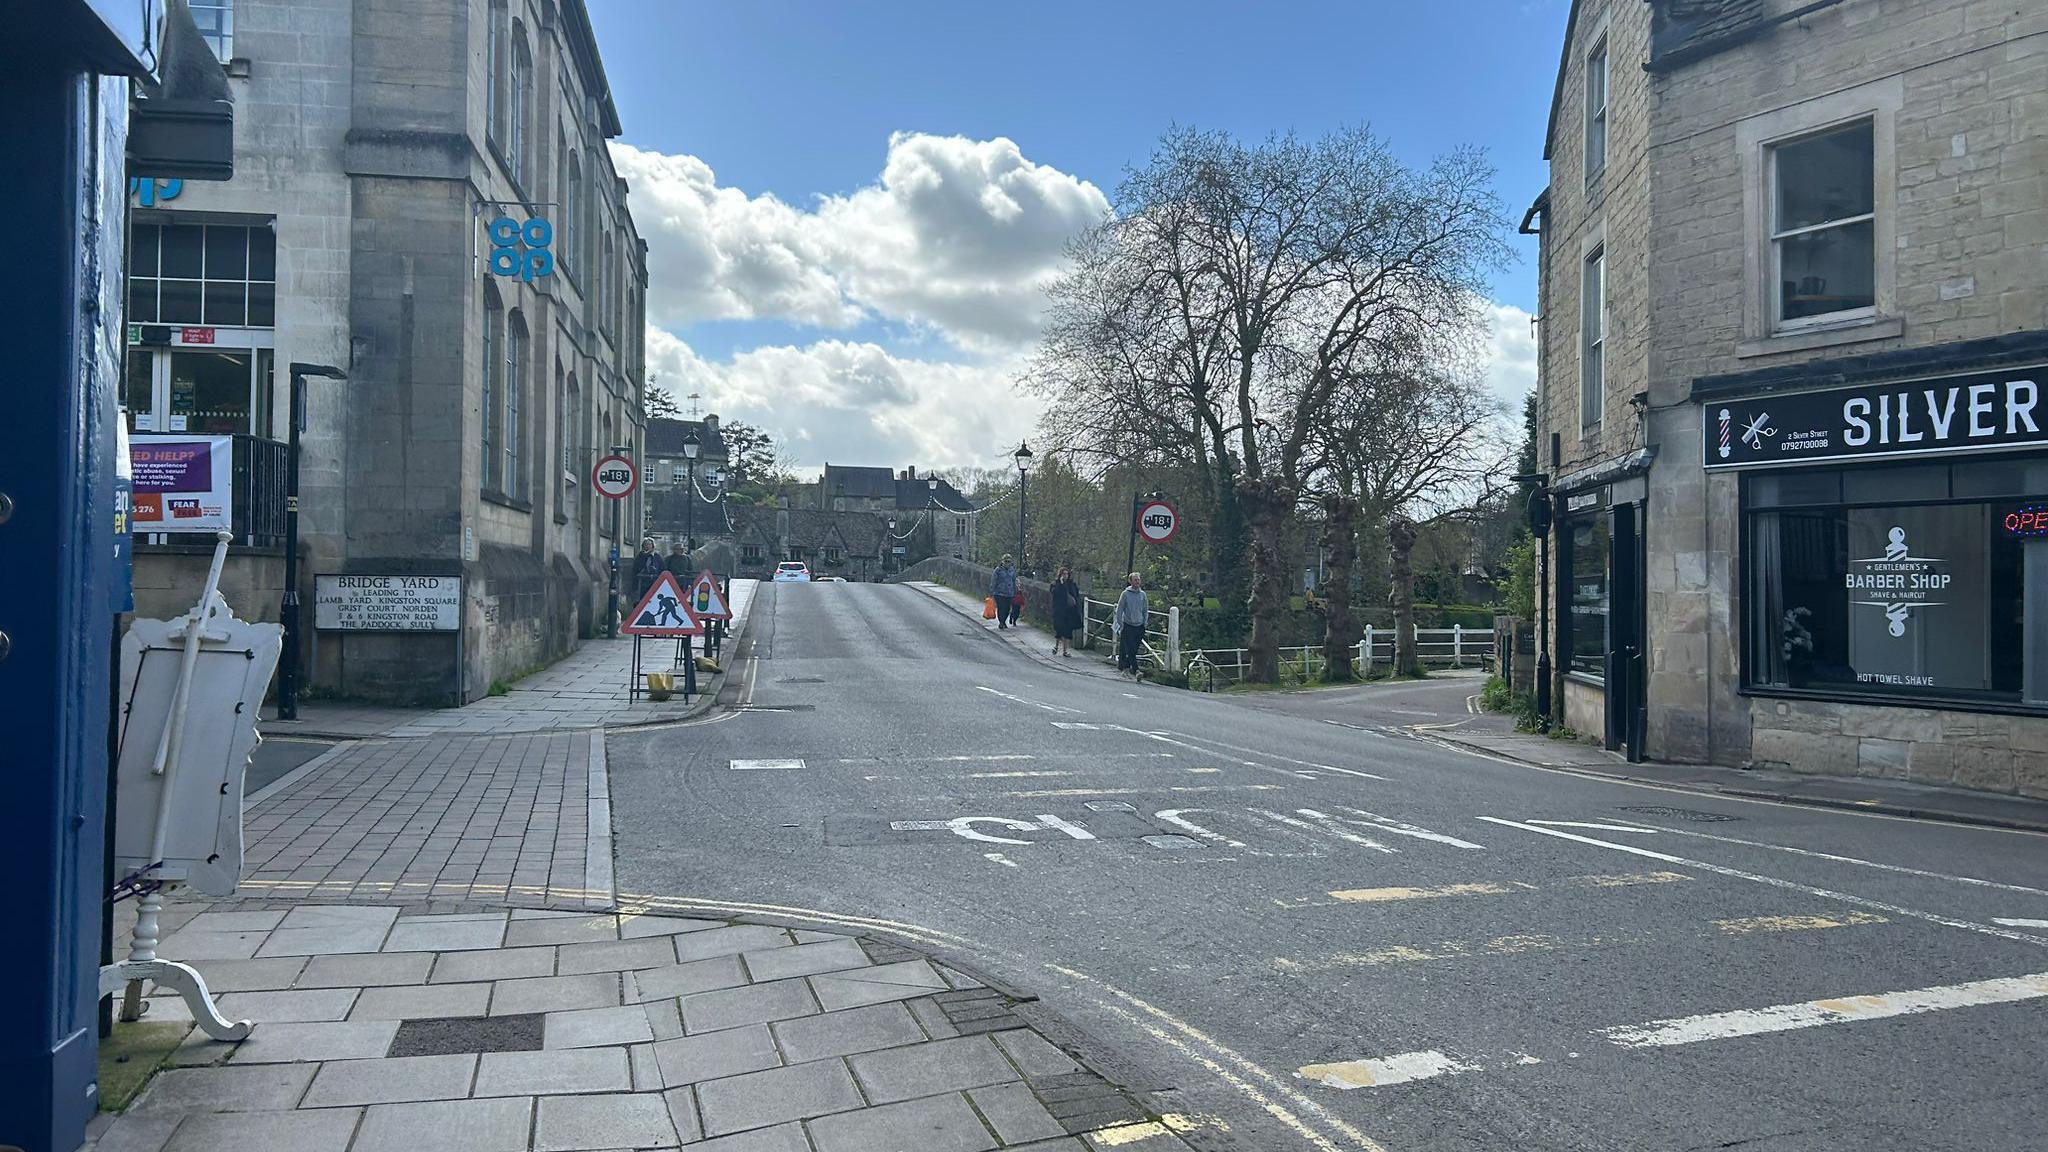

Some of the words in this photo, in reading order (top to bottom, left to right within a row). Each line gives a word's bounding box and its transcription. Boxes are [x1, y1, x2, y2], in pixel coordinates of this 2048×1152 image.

[1844, 379, 2040, 446] SILVER
[154, 451, 195, 461] HELP?
[138, 505, 155, 513] 276
[2005, 513, 2048, 529] OPE
[1874, 563, 1921, 571] GENTLEMEN'S
[338, 577, 390, 588] BRIDGE
[400, 577, 439, 589] YARD
[1846, 573, 1905, 589] BARBER
[1910, 573, 1951, 589] SHOP
[363, 589, 399, 597] LEADING
[403, 589, 415, 597] TO
[1870, 591, 1890, 599] SHAVE
[1899, 591, 1926, 599] HAIRCUT
[320, 596, 344, 604] LAMB
[379, 597, 421, 605] KINGSTON
[424, 597, 457, 605] SQUARE
[338, 604, 361, 612] GRIST
[410, 621, 436, 629] SULLY
[1857, 673, 1874, 682] HOT
[1874, 673, 1903, 684] TOWEL
[1905, 674, 1934, 686] SHAVE
